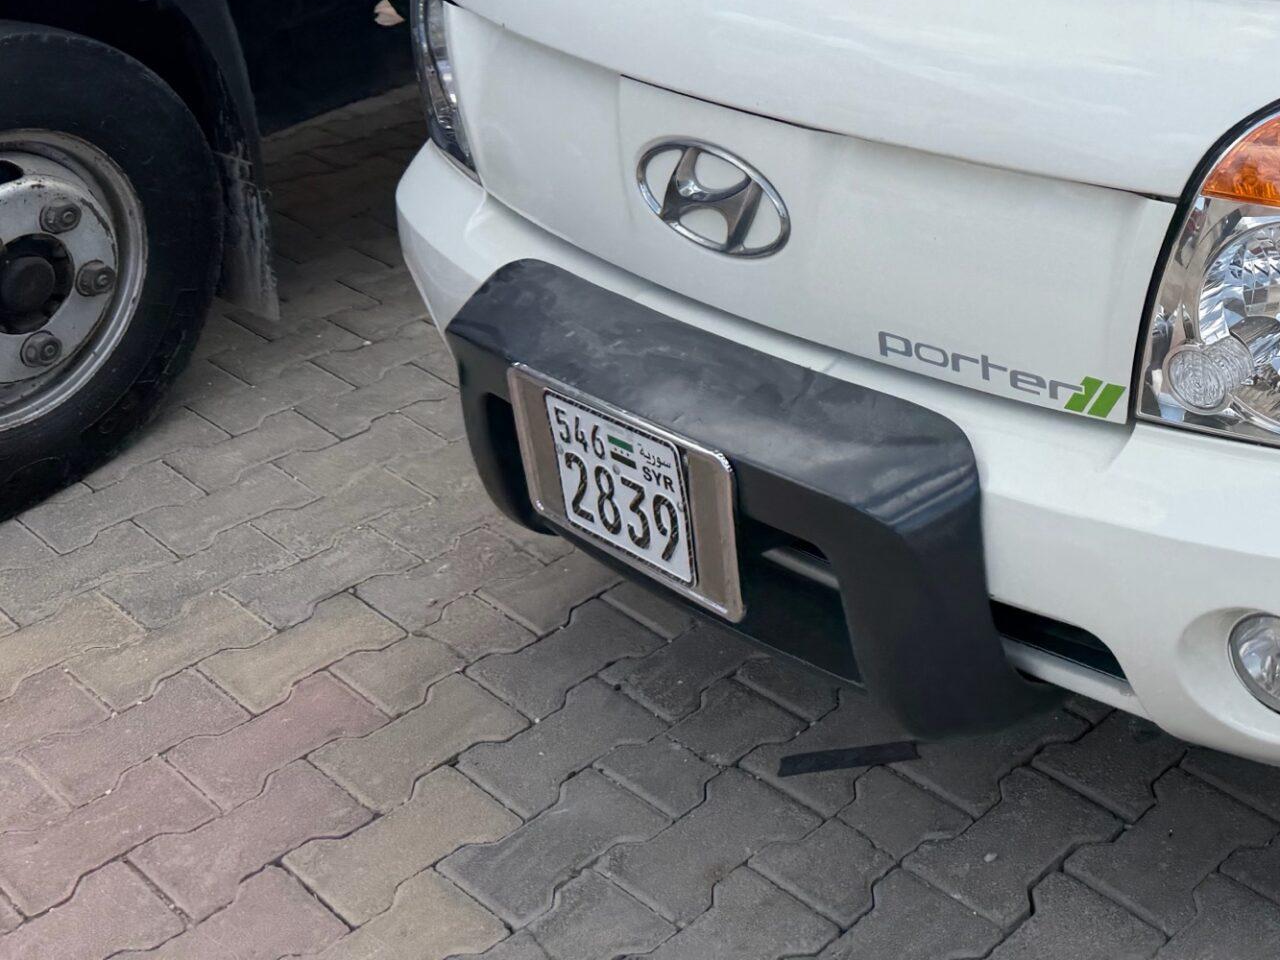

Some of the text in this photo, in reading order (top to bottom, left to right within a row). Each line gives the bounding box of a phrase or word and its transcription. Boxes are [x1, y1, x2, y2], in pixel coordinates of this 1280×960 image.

[878, 331, 1085, 400] porter
[554, 406, 605, 460] 546
[565, 452, 680, 561] 2839
[642, 465, 676, 493] SYR
